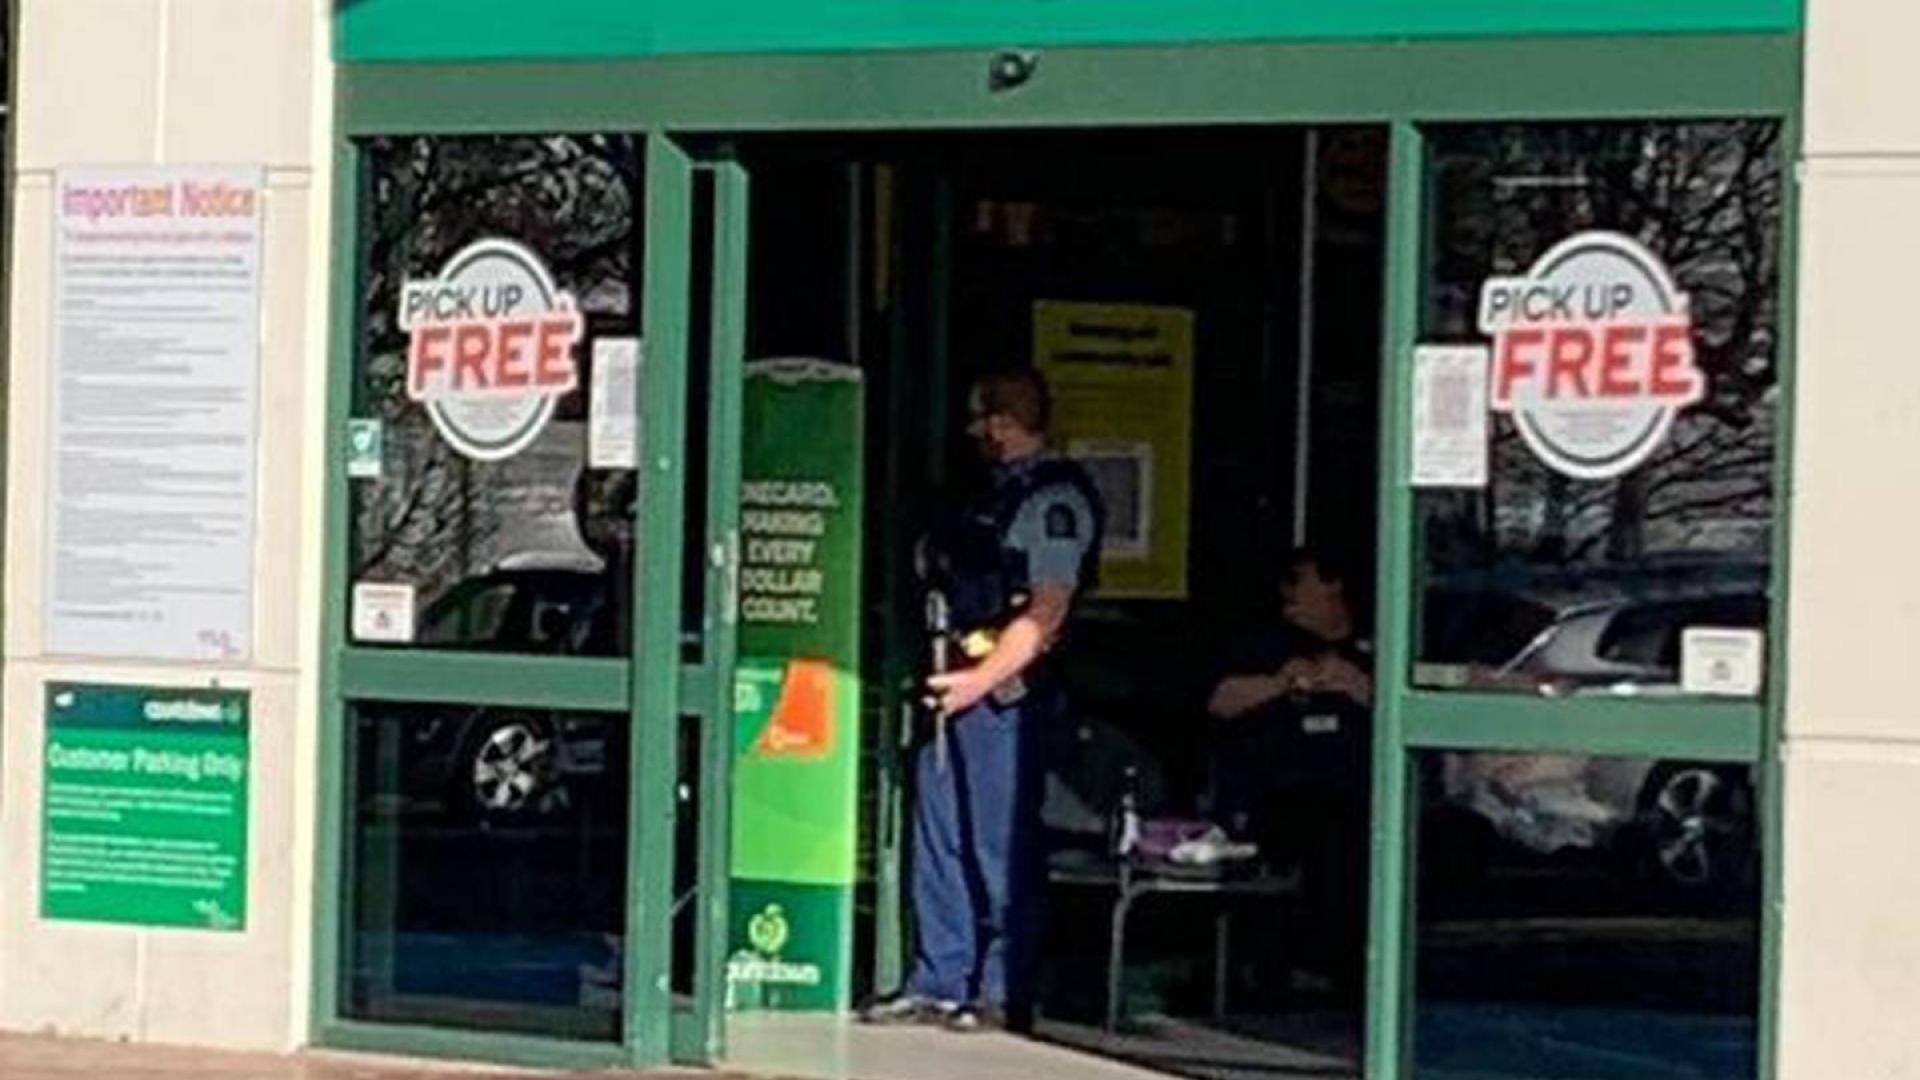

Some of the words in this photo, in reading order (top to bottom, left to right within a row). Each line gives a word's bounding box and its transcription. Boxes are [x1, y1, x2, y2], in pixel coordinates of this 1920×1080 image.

[406, 286, 477, 320] PICK
[484, 285, 523, 317] UP
[1487, 285, 1579, 322] PICK
[1583, 283, 1634, 319] UP
[414, 321, 576, 391] FREE
[1498, 325, 1693, 402] FREE
[748, 538, 816, 563] EVERY
[133, 746, 199, 782] Parking
